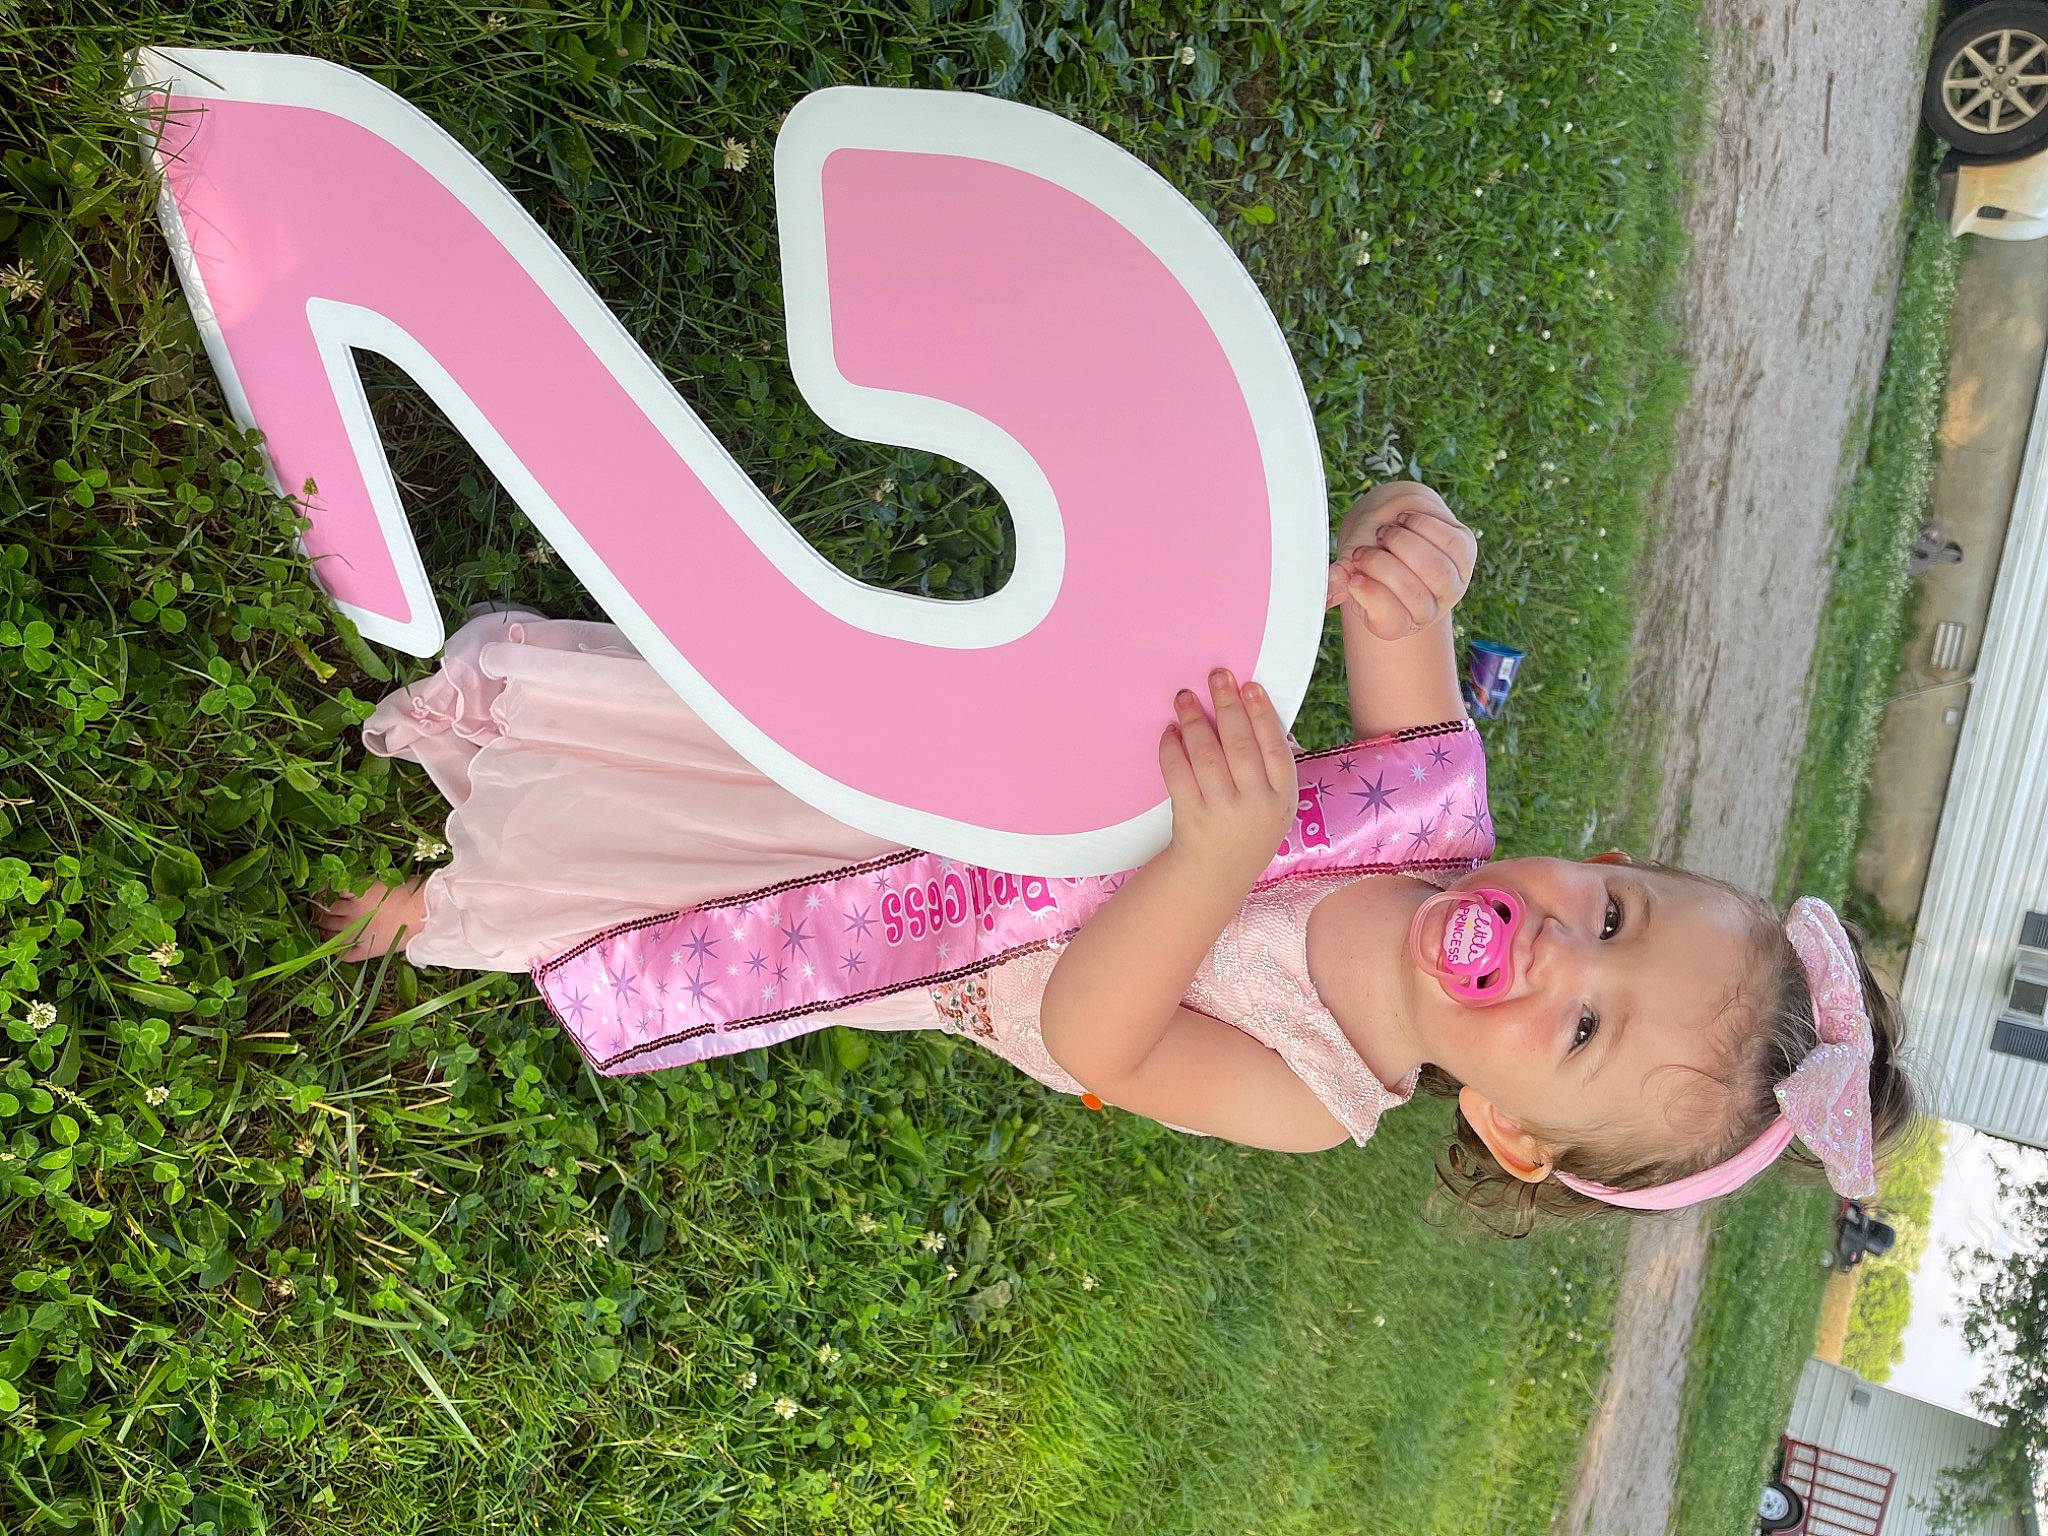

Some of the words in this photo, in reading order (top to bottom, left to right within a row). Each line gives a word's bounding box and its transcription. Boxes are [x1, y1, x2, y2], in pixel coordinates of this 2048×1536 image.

[126, 48, 1330, 877] 2
[1447, 907, 1470, 963] PRINCESS
[1468, 909, 1490, 963] little
